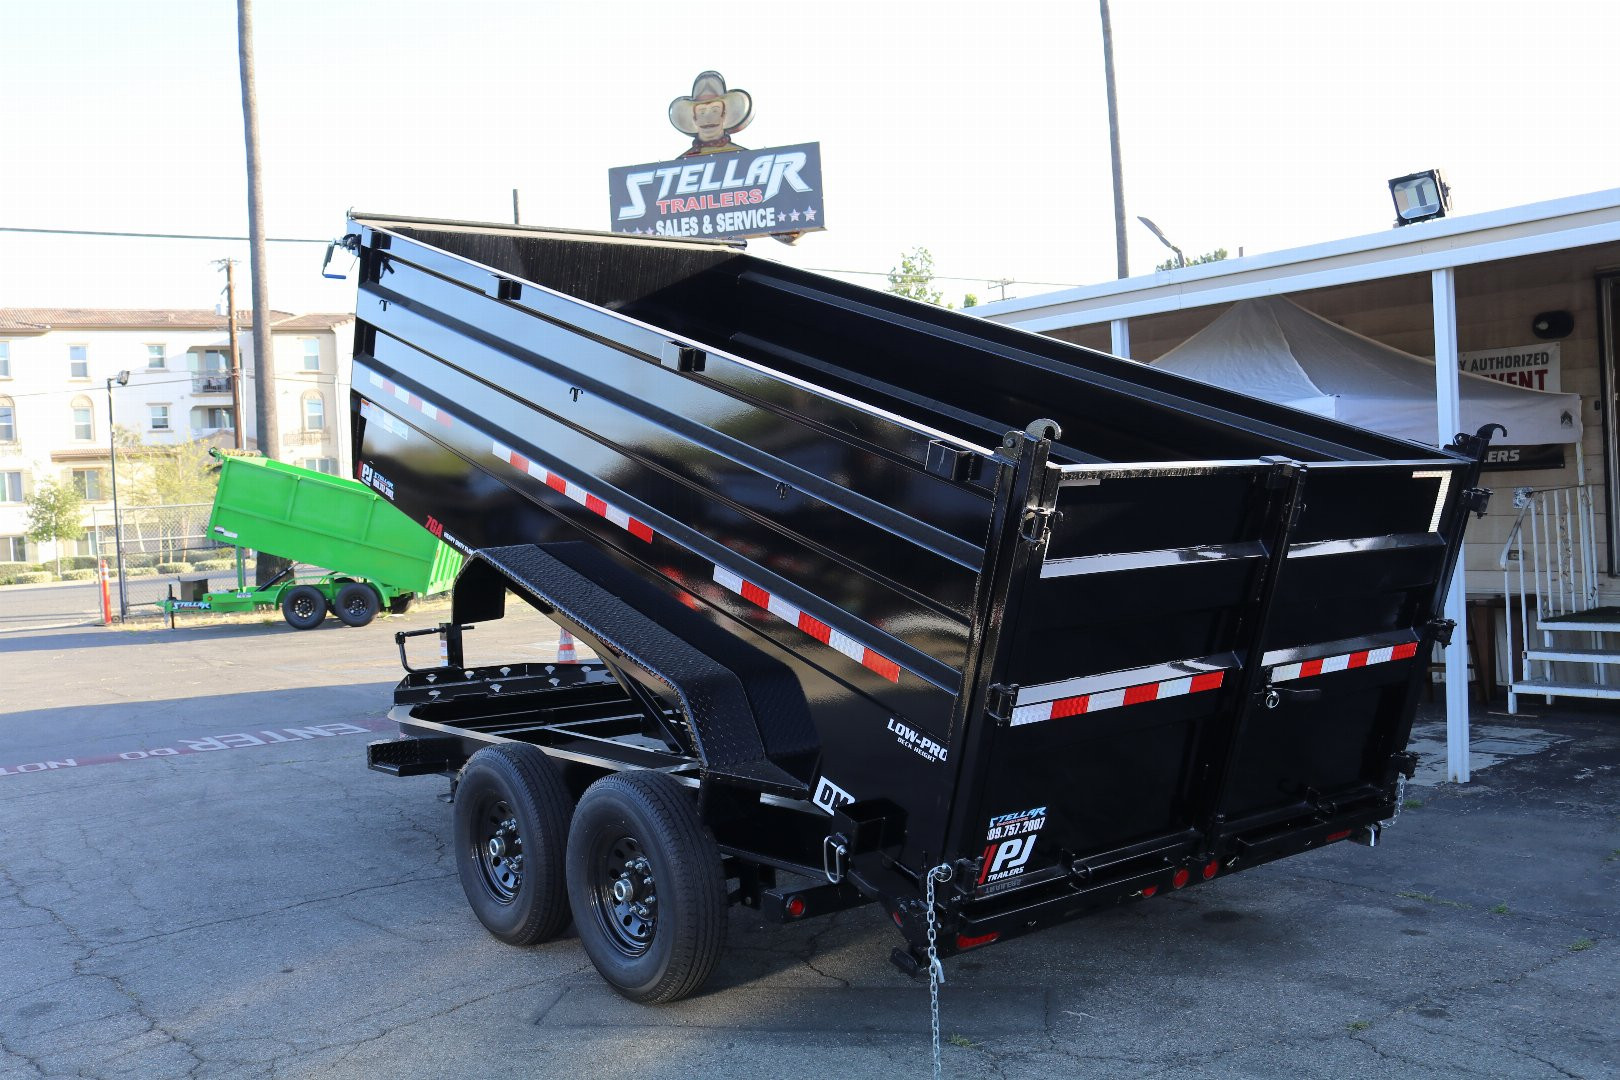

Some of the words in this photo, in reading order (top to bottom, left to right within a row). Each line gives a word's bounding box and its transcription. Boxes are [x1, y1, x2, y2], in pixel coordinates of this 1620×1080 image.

[617, 151, 813, 220] STELLAR
[656, 188, 763, 214] TRAILERS
[655, 217, 698, 237] SALES
[702, 214, 713, 234] &
[716, 207, 775, 232] SERVICE
[1471, 352, 1549, 372] AUTHORIZED
[425, 515, 443, 538] 7GA
[178, 722, 371, 751] ENTER
[887, 718, 947, 761] LOW-PRO
[119, 747, 179, 760] DO
[913, 746, 936, 762] HEIGHT
[986, 817, 1046, 841] 09.757.2007
[990, 834, 1037, 873] PJ
[988, 866, 1025, 882] TRAILERS
